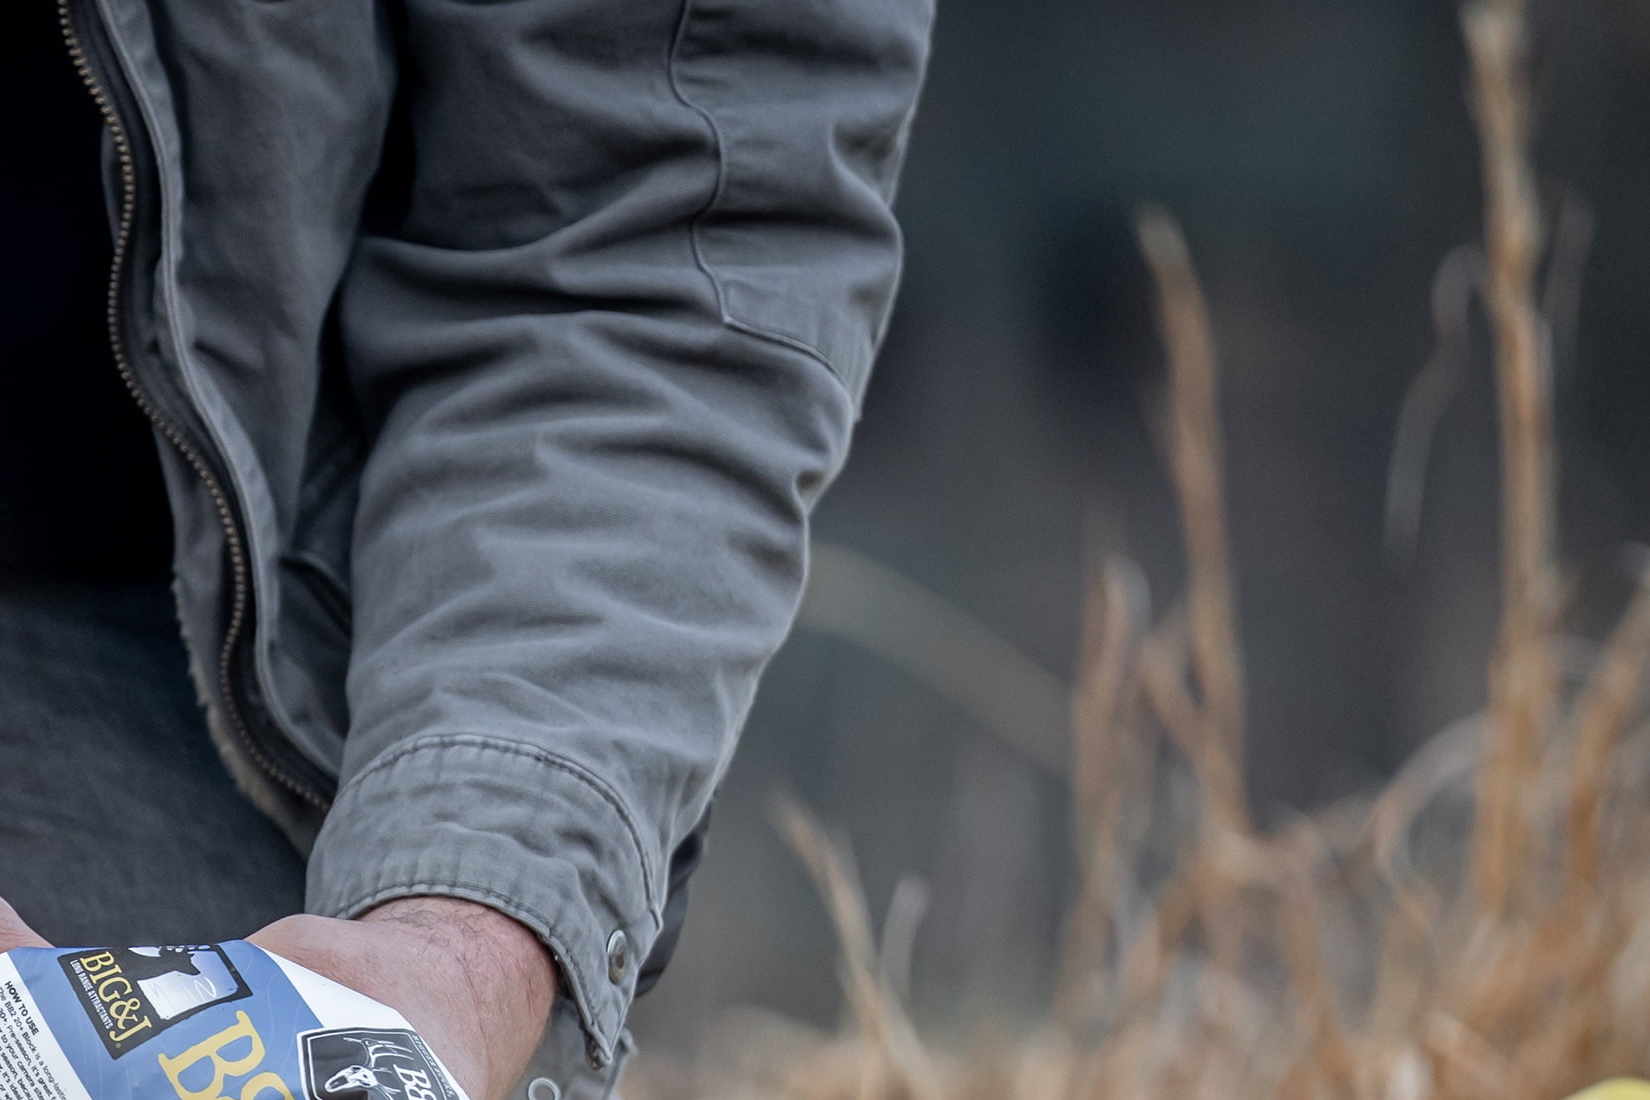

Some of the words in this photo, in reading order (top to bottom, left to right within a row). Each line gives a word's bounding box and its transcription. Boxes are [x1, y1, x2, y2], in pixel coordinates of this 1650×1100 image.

[4, 981, 22, 1003] HOW
[18, 1003, 28, 1017] TO
[25, 1016, 39, 1036] USE
[70, 959, 84, 974] LONG
[78, 972, 94, 992] RANGE
[87, 990, 113, 1029] ATTRACTANTS
[79, 951, 152, 1043] BIG&J
[4, 1001, 17, 1017] BB2
[13, 1017, 23, 1031] 20+
[22, 1031, 37, 1053] Block
[34, 1052, 41, 1060] is
[1, 1034, 8, 1044] to
[5, 1043, 19, 1060] your
[17, 1061, 35, 1087] camera
[2, 1071, 11, 1084] it's
[9, 1083, 24, 1100] ideal
[31, 1066, 40, 1077] it's
[37, 1077, 52, 1097] great
